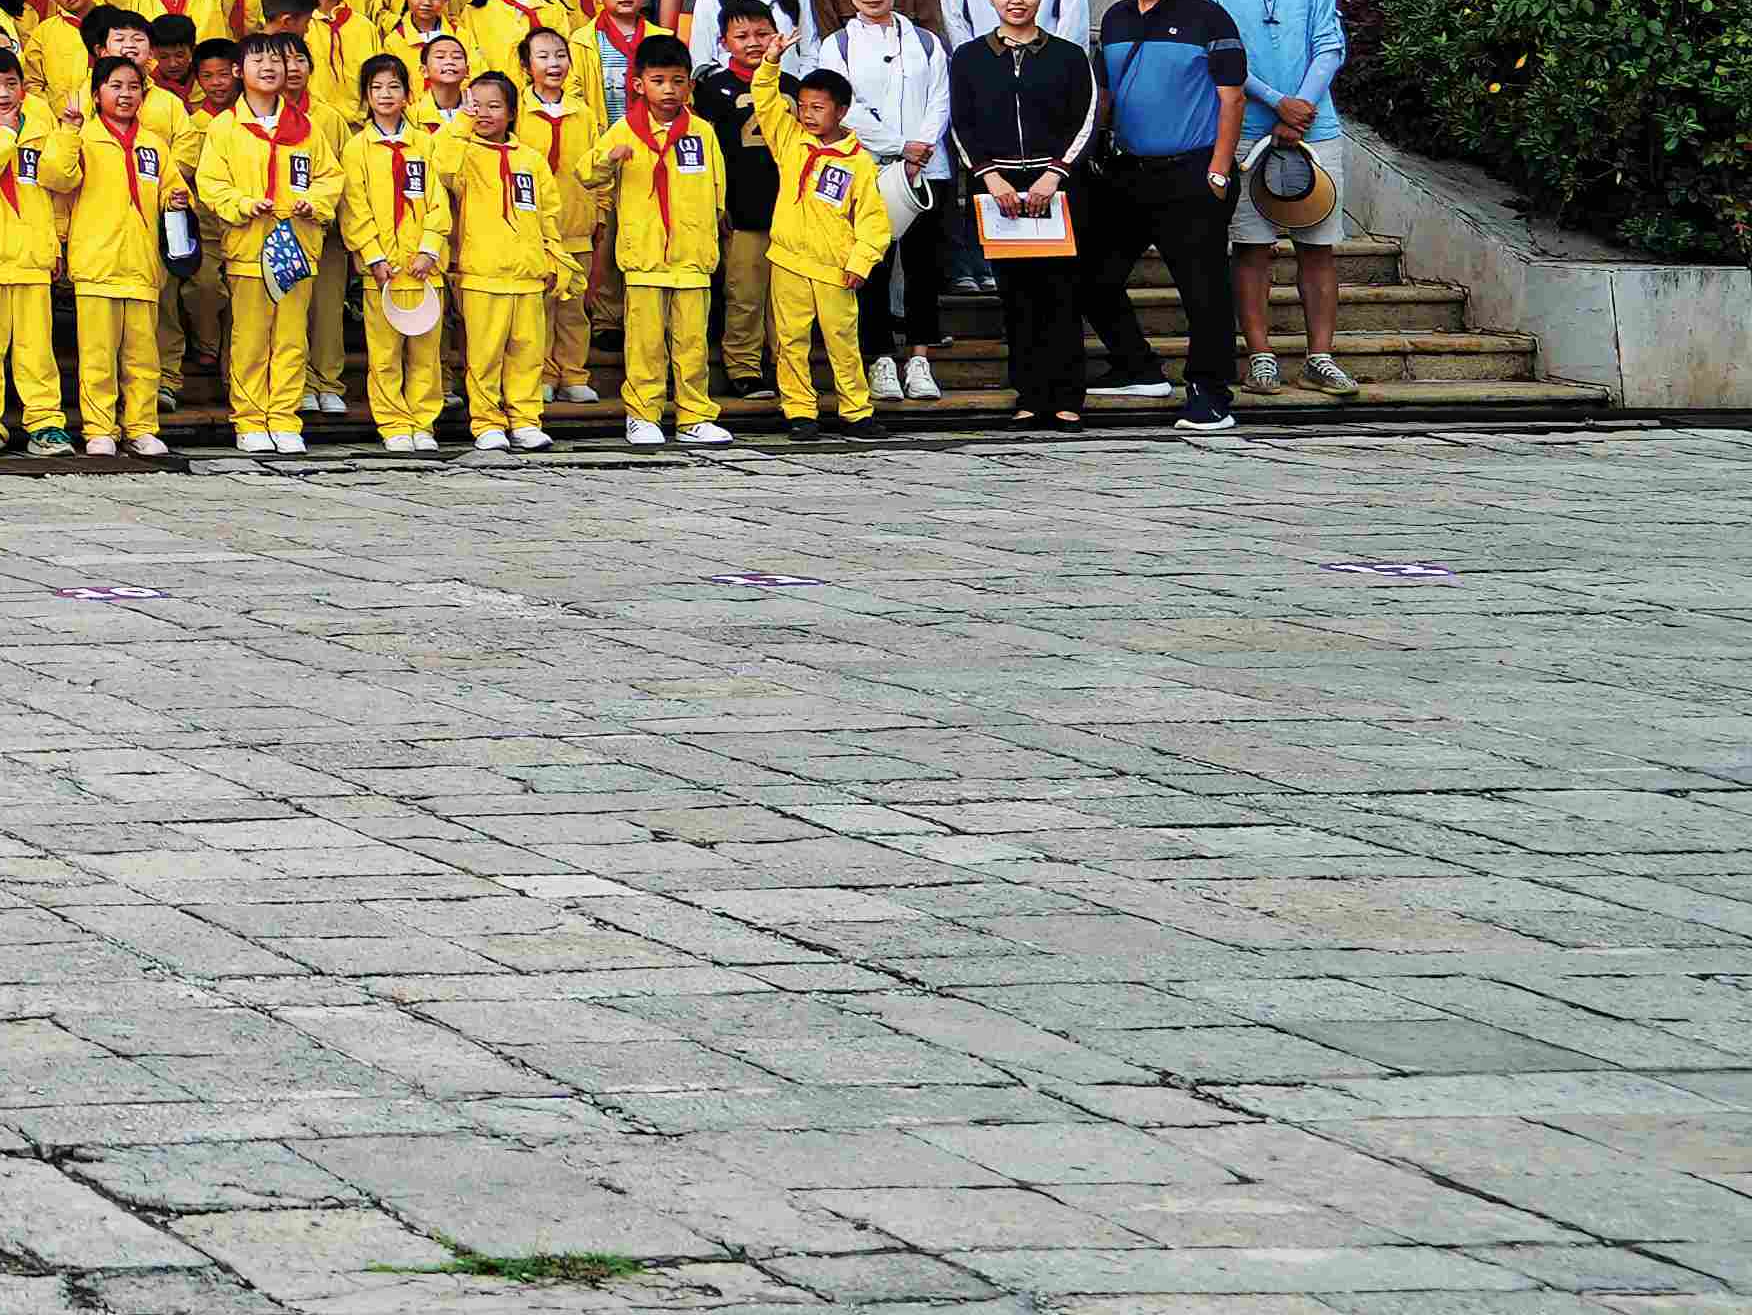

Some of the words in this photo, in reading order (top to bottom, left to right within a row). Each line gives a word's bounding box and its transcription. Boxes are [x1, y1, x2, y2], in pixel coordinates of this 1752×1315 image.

[679, 136, 698, 151] (1)
[138, 147, 156, 161] (1)
[405, 162, 423, 177] (1)
[826, 168, 845, 183] (1)
[516, 174, 531, 189] (1)
